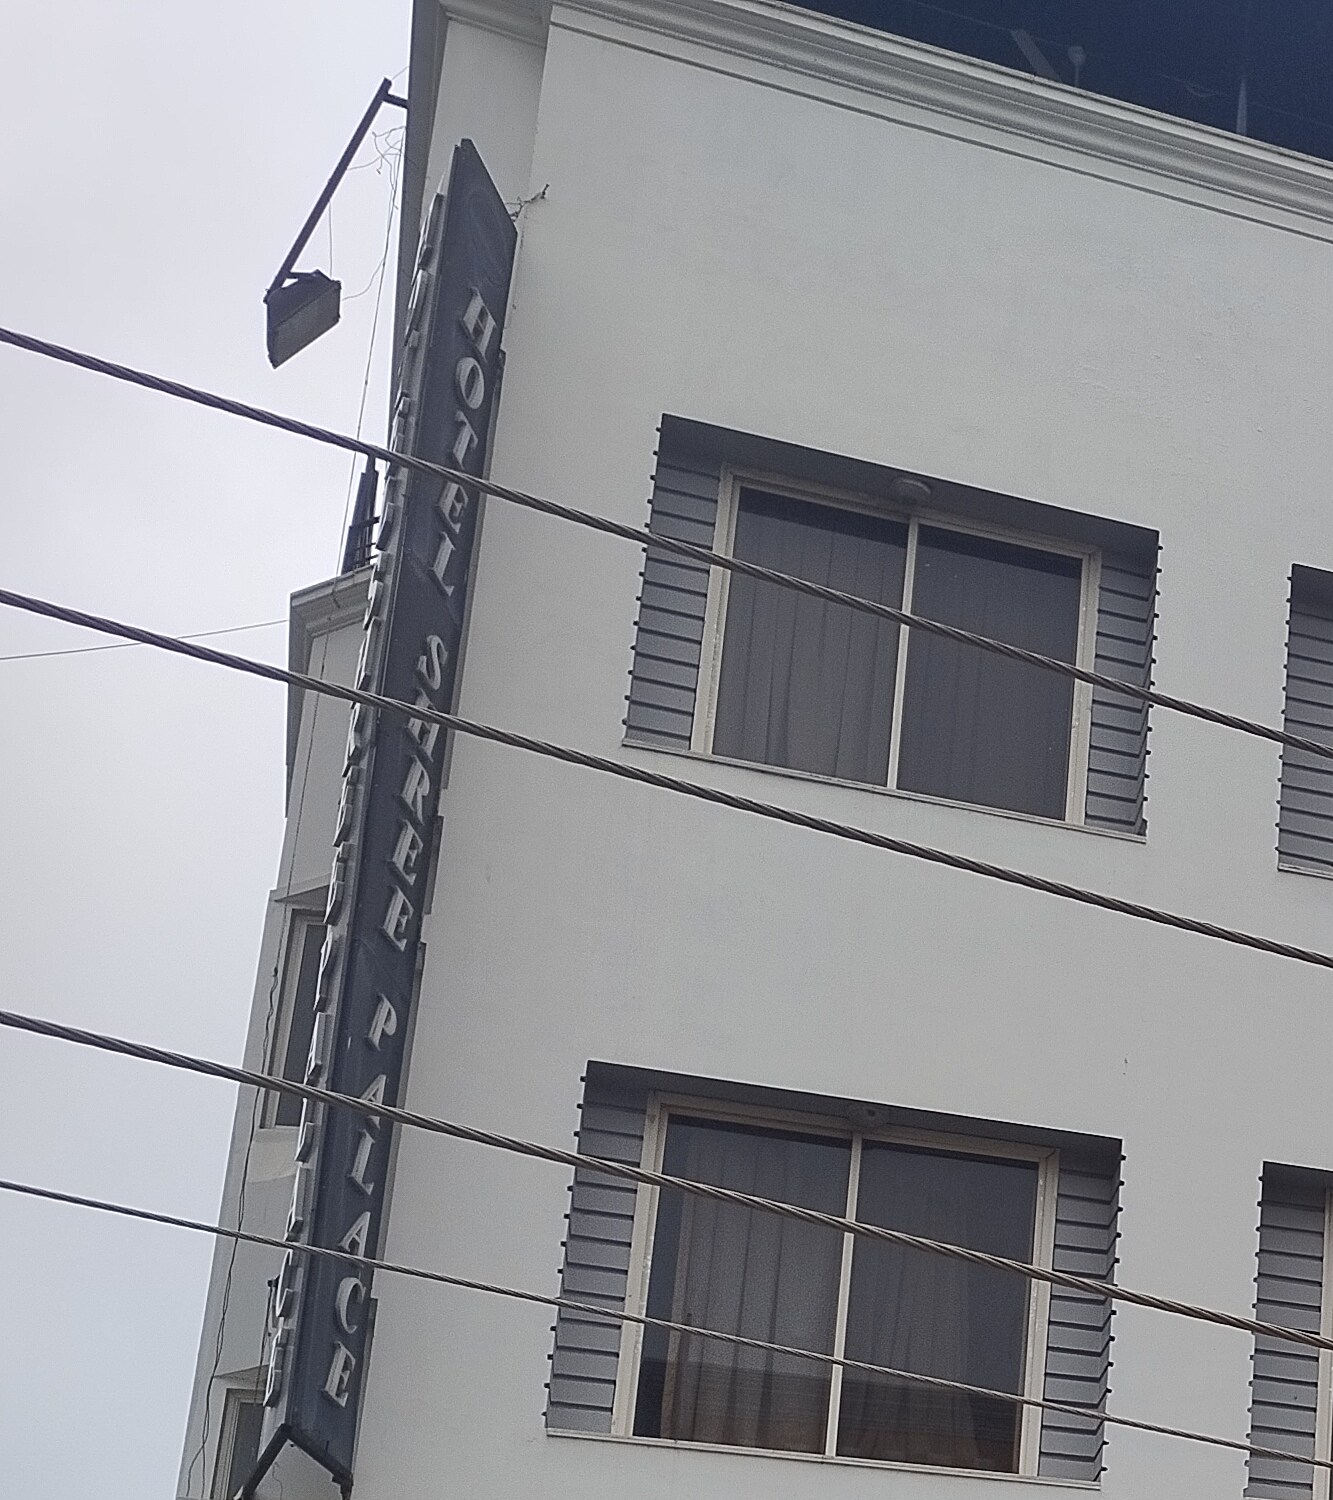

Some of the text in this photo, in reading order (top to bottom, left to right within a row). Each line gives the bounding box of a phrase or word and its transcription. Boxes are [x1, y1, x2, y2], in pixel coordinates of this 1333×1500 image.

[431, 288, 496, 598] HOTEL
[383, 634, 448, 952] SHREE
[324, 994, 397, 1407] PALACE
